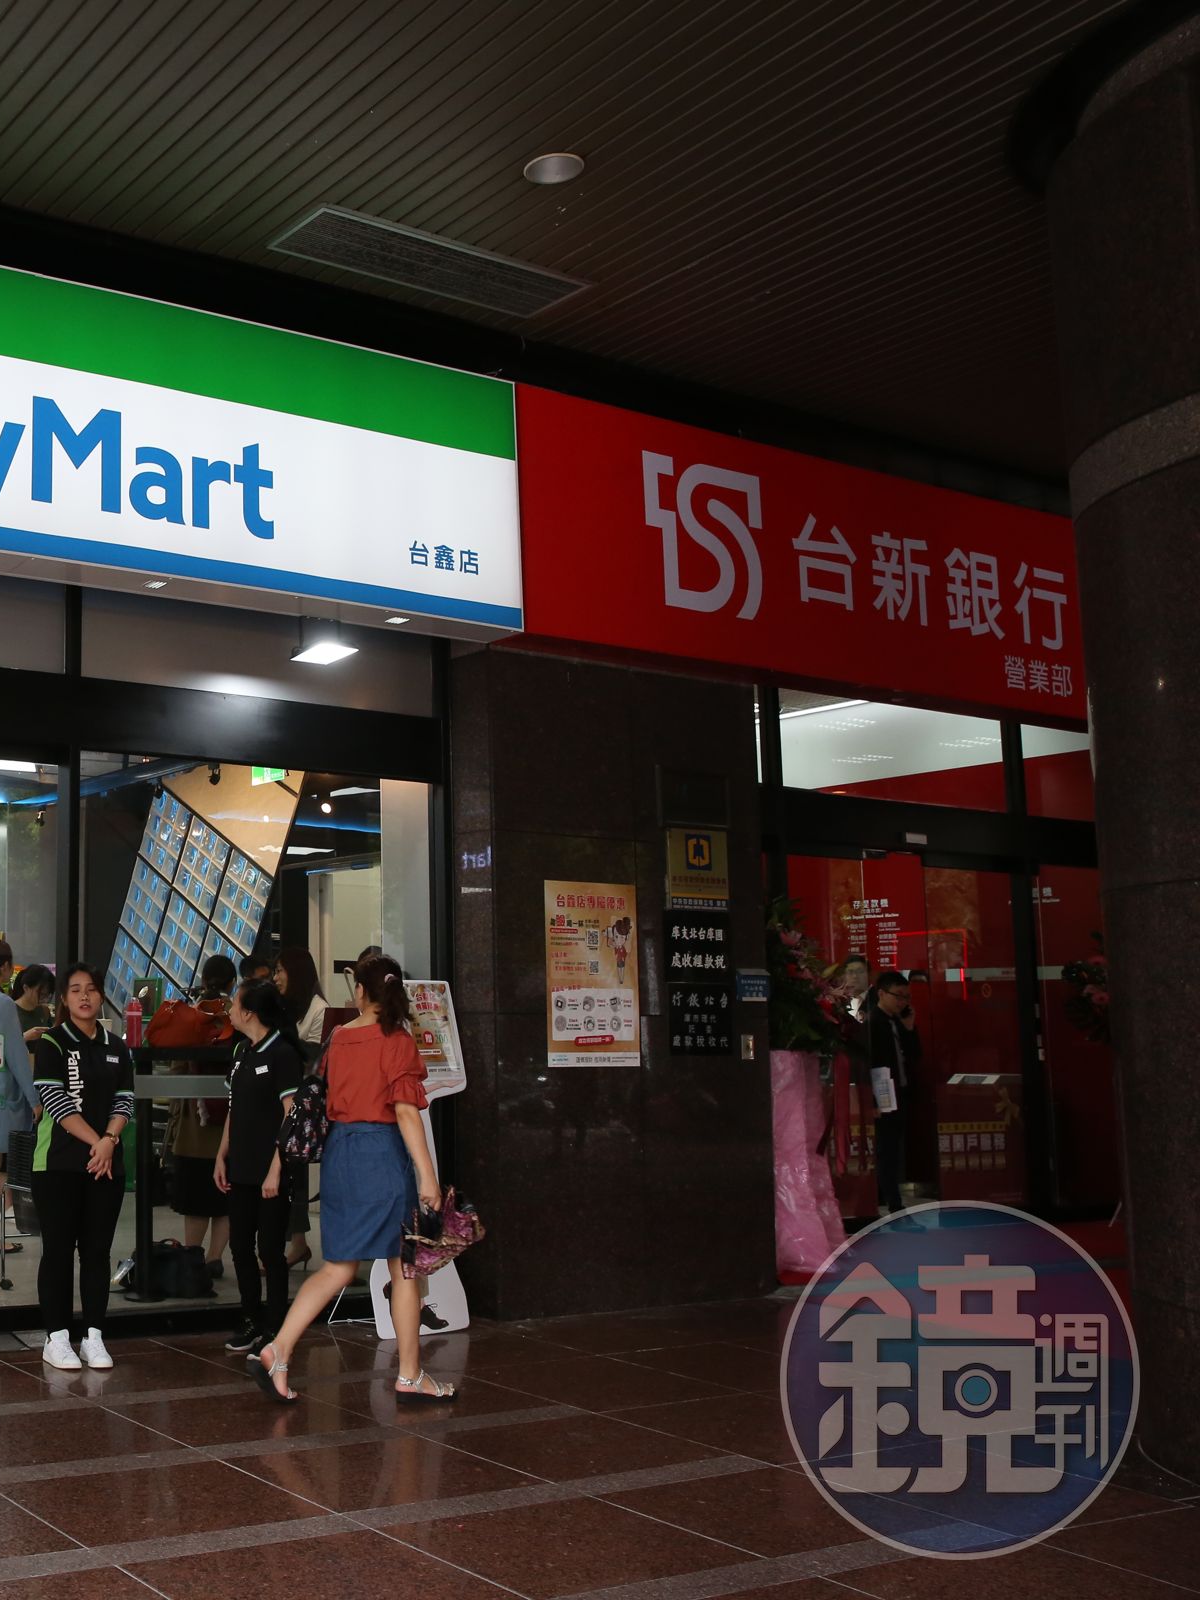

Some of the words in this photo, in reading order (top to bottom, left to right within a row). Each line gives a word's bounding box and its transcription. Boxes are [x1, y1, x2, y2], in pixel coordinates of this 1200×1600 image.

[409, 540, 479, 576] 台鑫店
[792, 513, 1068, 651] 台新銀行
[1004, 655, 1073, 698] 營業部
[66, 1049, 84, 1113] FamilyM
